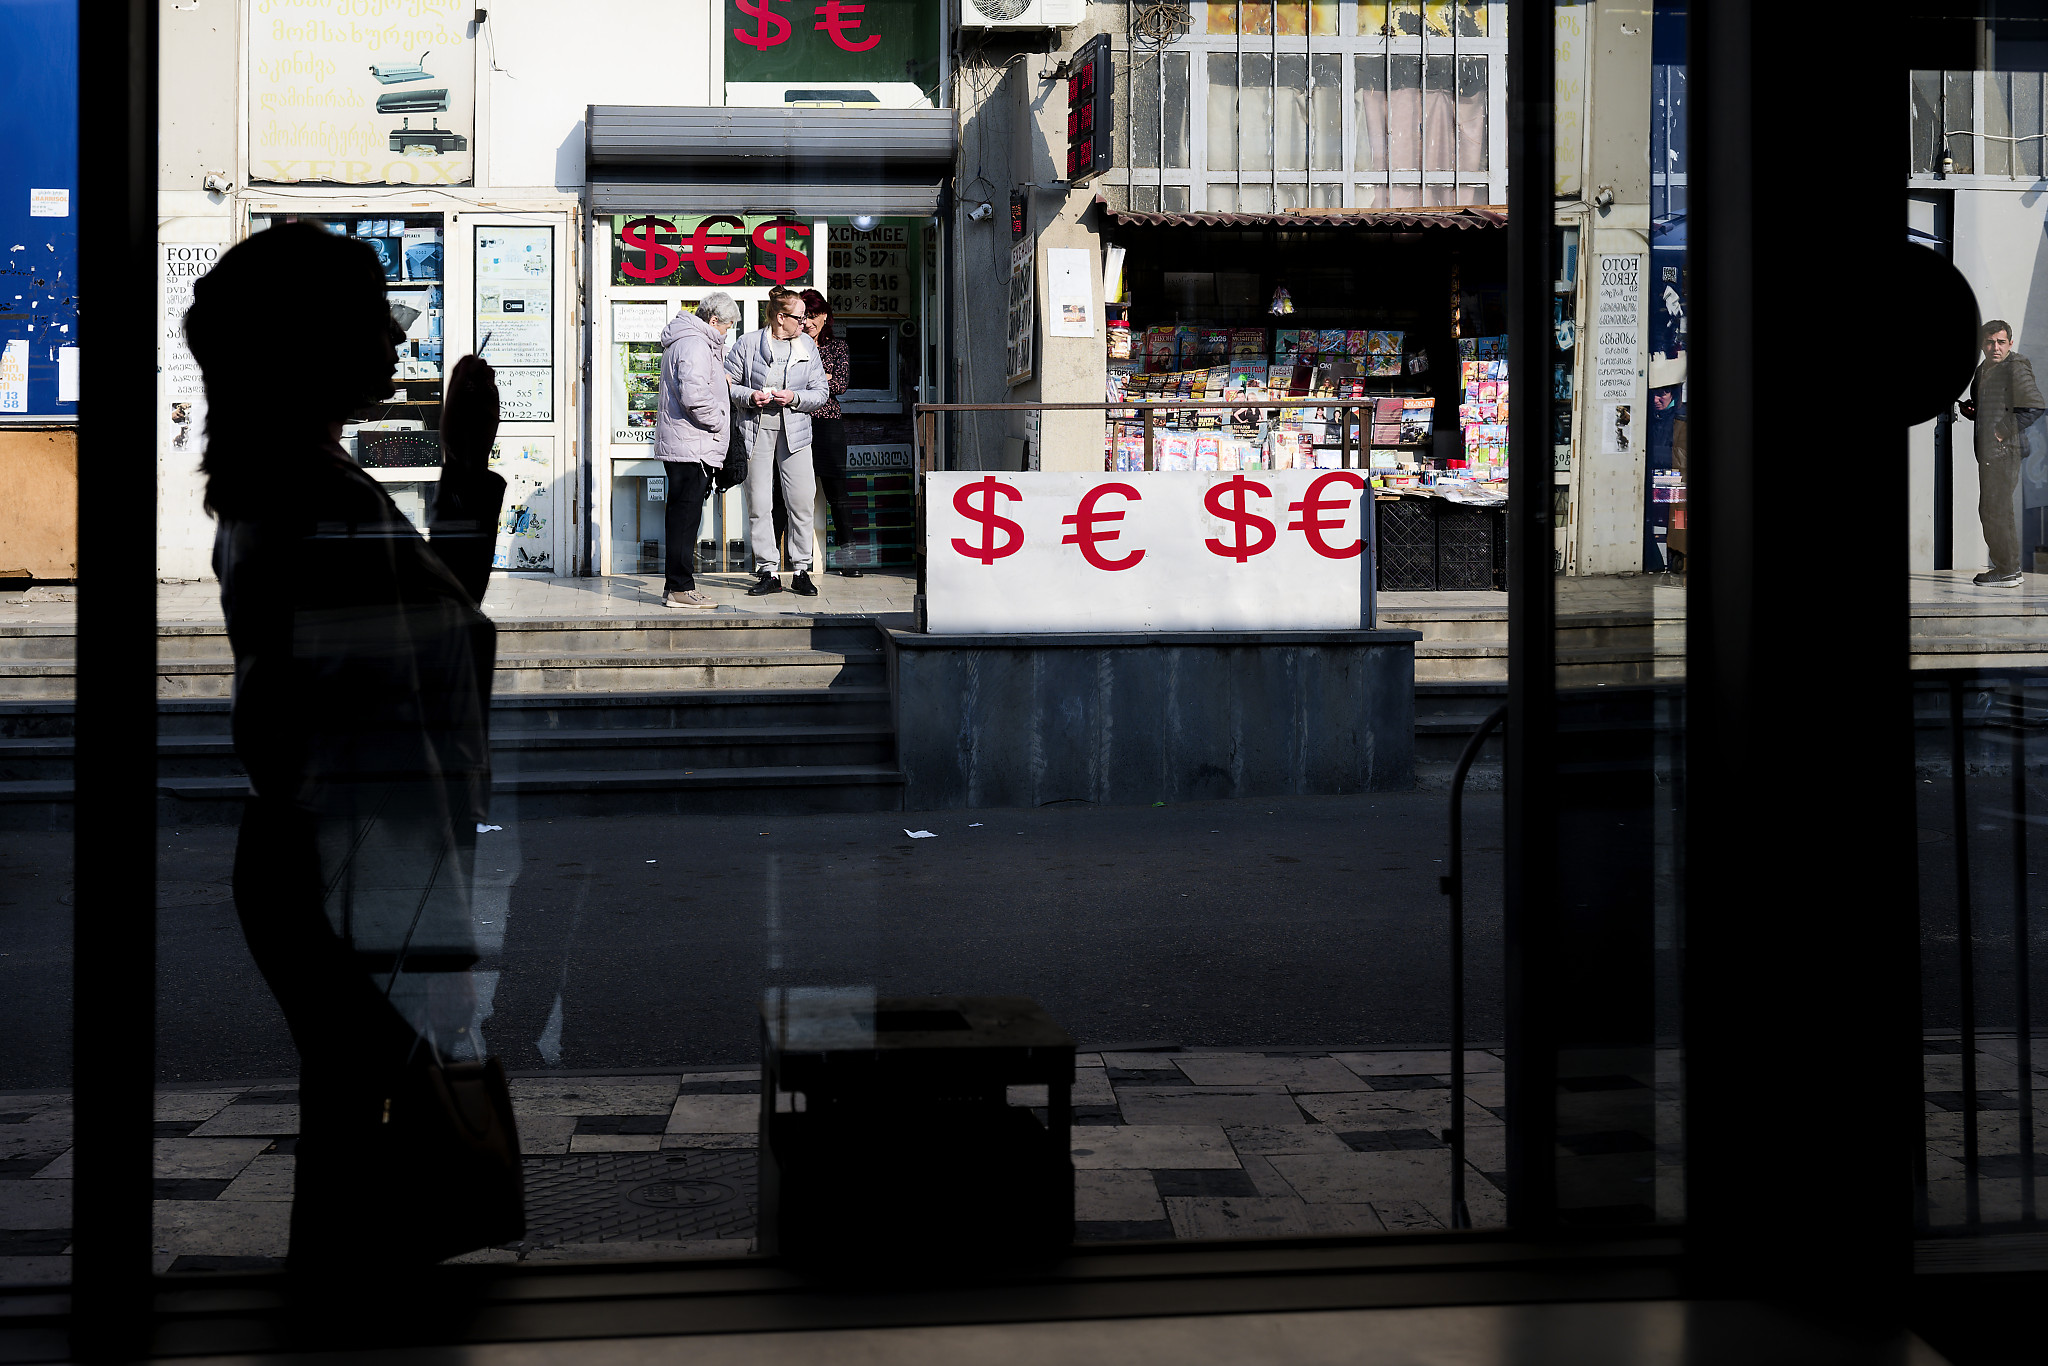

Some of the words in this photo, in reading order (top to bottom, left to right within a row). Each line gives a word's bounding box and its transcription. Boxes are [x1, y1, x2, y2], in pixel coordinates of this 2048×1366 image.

[272, 18, 462, 51] მომსახურეობა
[258, 50, 336, 83] აკინძვა
[261, 160, 462, 184] XEROX
[828, 227, 904, 241] XCHANGE
[166, 247, 218, 261] FOTO
[616, 430, 656, 442] თაფლ
[849, 450, 909, 467] გადაცვლა
[951, 475, 1025, 566] $
[1062, 482, 1146, 572] €
[1204, 474, 1277, 564] $
[1287, 471, 1364, 560] €
